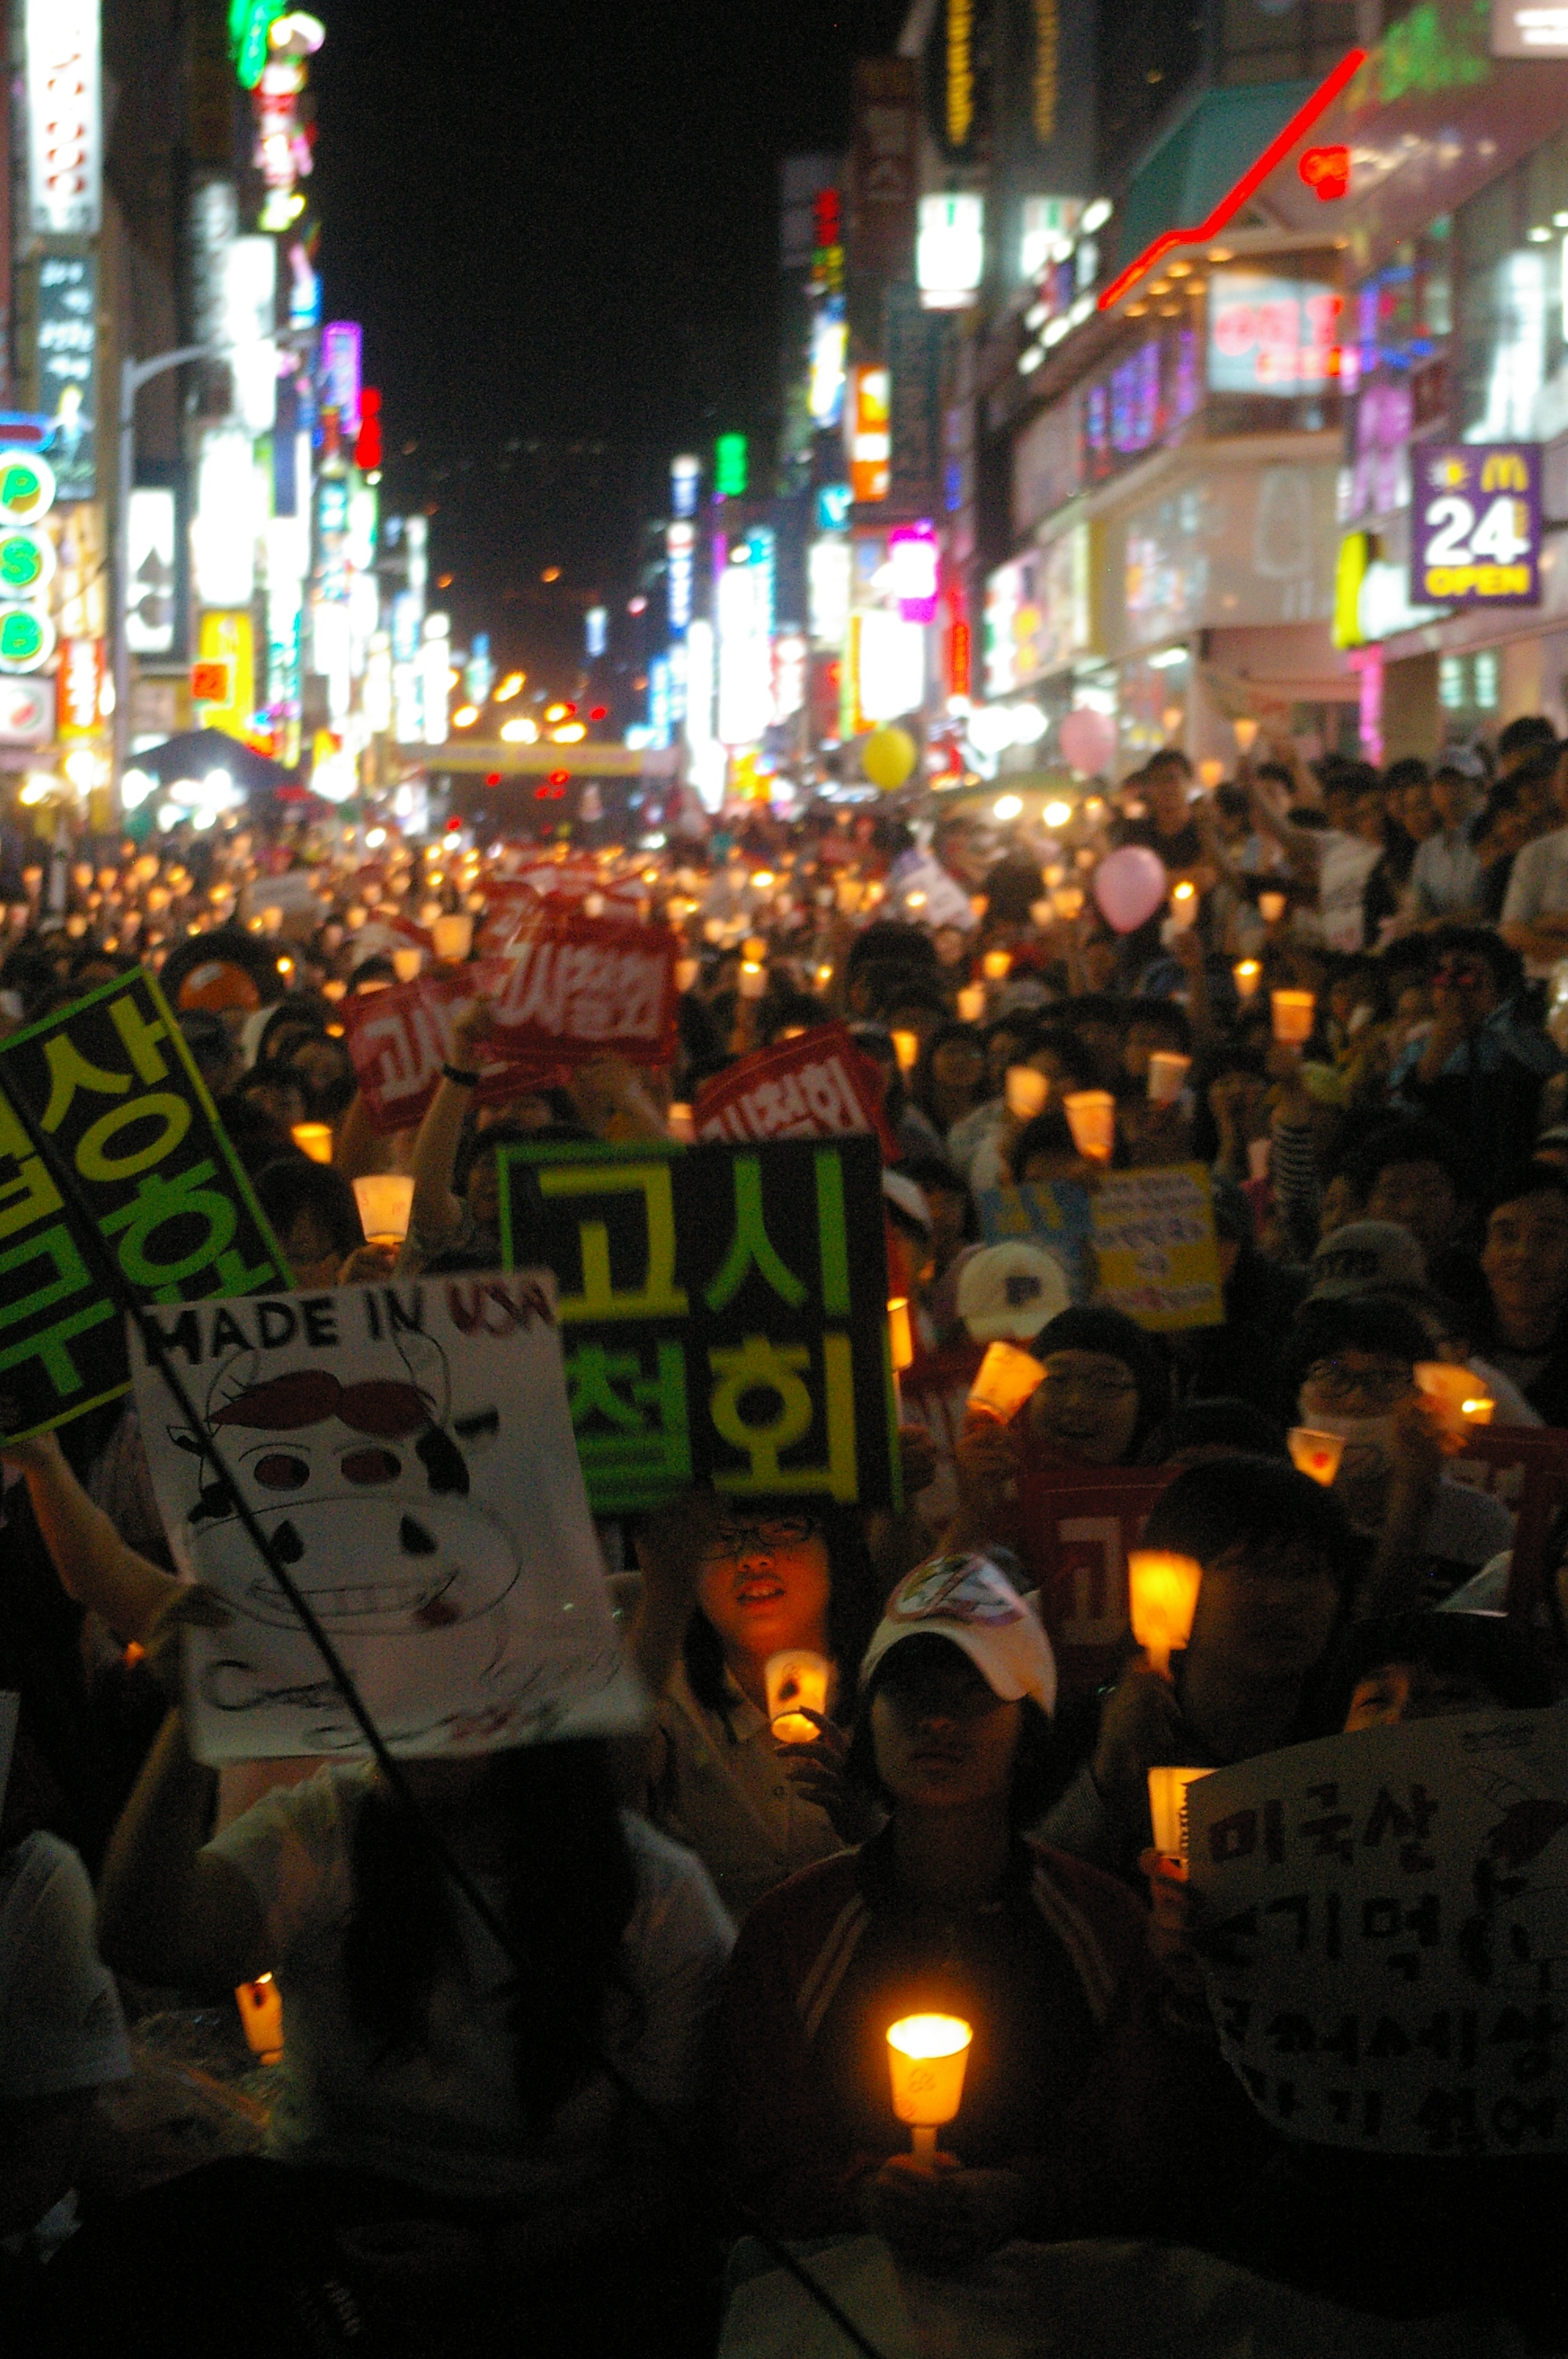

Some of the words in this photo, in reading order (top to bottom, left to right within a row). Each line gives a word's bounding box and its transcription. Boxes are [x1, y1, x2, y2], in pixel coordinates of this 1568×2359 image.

[1425, 496, 1531, 567] 24
[1424, 563, 1532, 597] OPEN
[539, 1147, 852, 1322] 고시
[143, 1296, 339, 1367] MADE
[368, 1289, 425, 1338] IN
[446, 1280, 552, 1337] USA
[1208, 1782, 1439, 1874] 미국산
